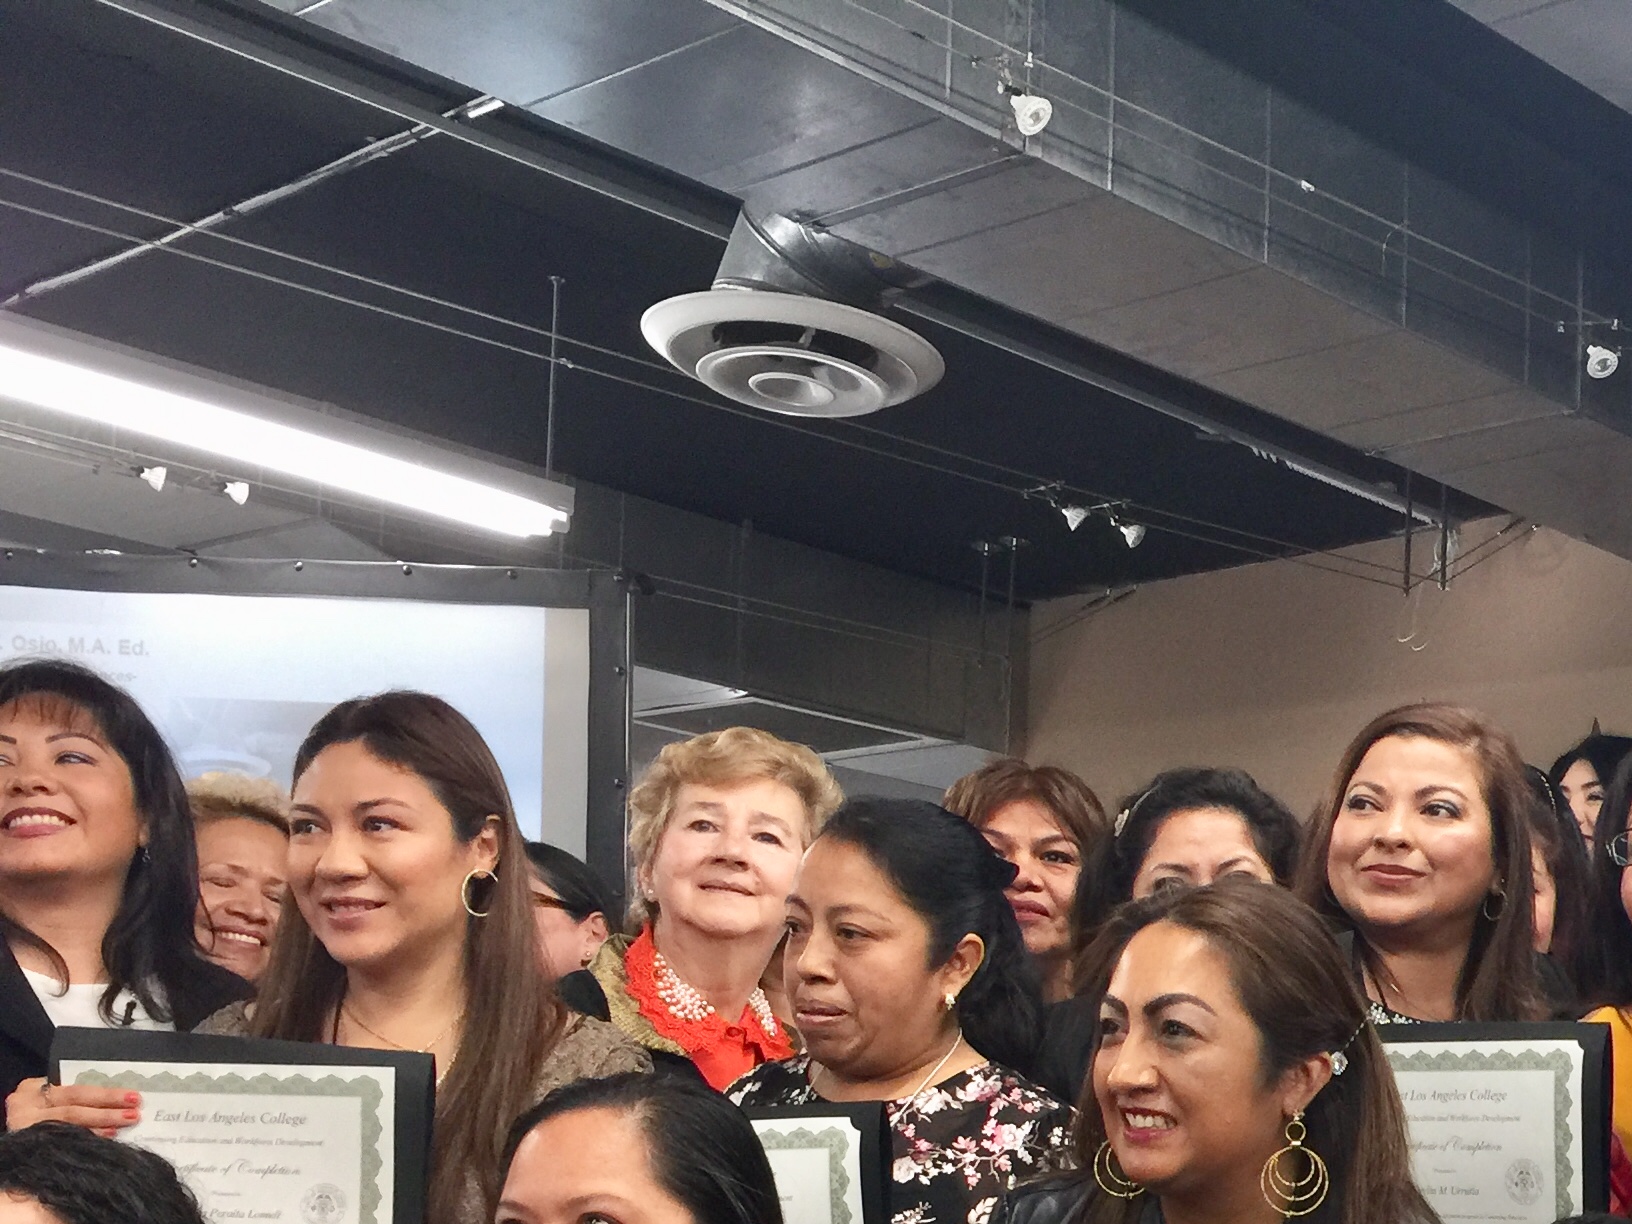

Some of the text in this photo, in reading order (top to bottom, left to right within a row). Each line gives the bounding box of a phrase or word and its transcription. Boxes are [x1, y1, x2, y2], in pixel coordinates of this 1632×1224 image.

[67, 636, 111, 654] M.A.
[118, 638, 150, 656] Ed.
[154, 1109, 306, 1127] East Los Angeles College
